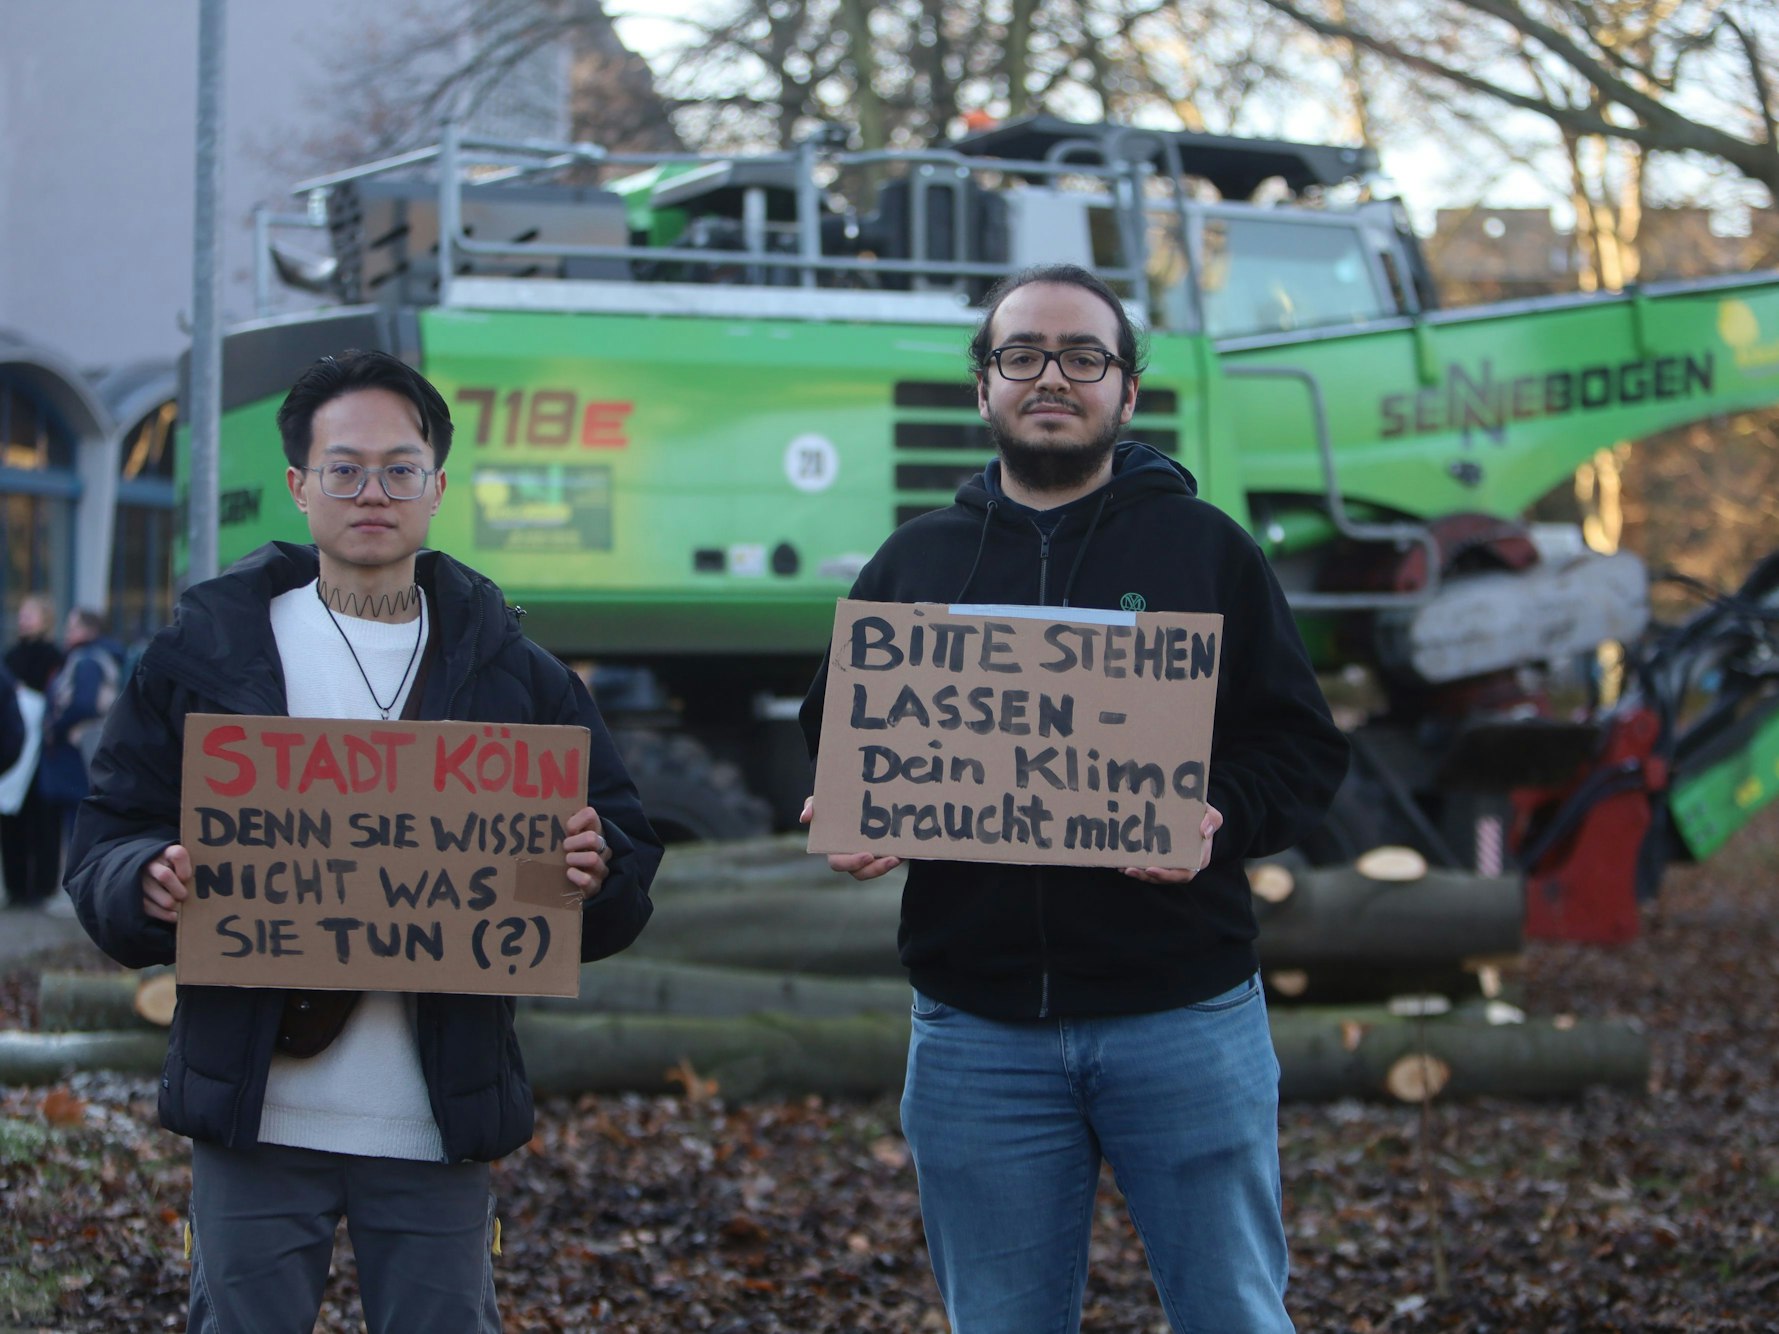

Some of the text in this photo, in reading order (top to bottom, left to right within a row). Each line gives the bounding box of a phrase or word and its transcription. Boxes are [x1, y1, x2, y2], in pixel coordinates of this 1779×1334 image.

[1039, 624, 1216, 681] STEHEN
[850, 683, 1074, 738] LASSEN
[202, 725, 580, 799] STADT KÖLN
[858, 740, 1206, 801] Dein Klima
[195, 807, 331, 849] DENN
[349, 813, 419, 849] SIE
[860, 790, 1171, 855] braucht mich
[195, 858, 498, 911] NICHT WAS
[216, 915, 551, 975] SIE TUN (?)
